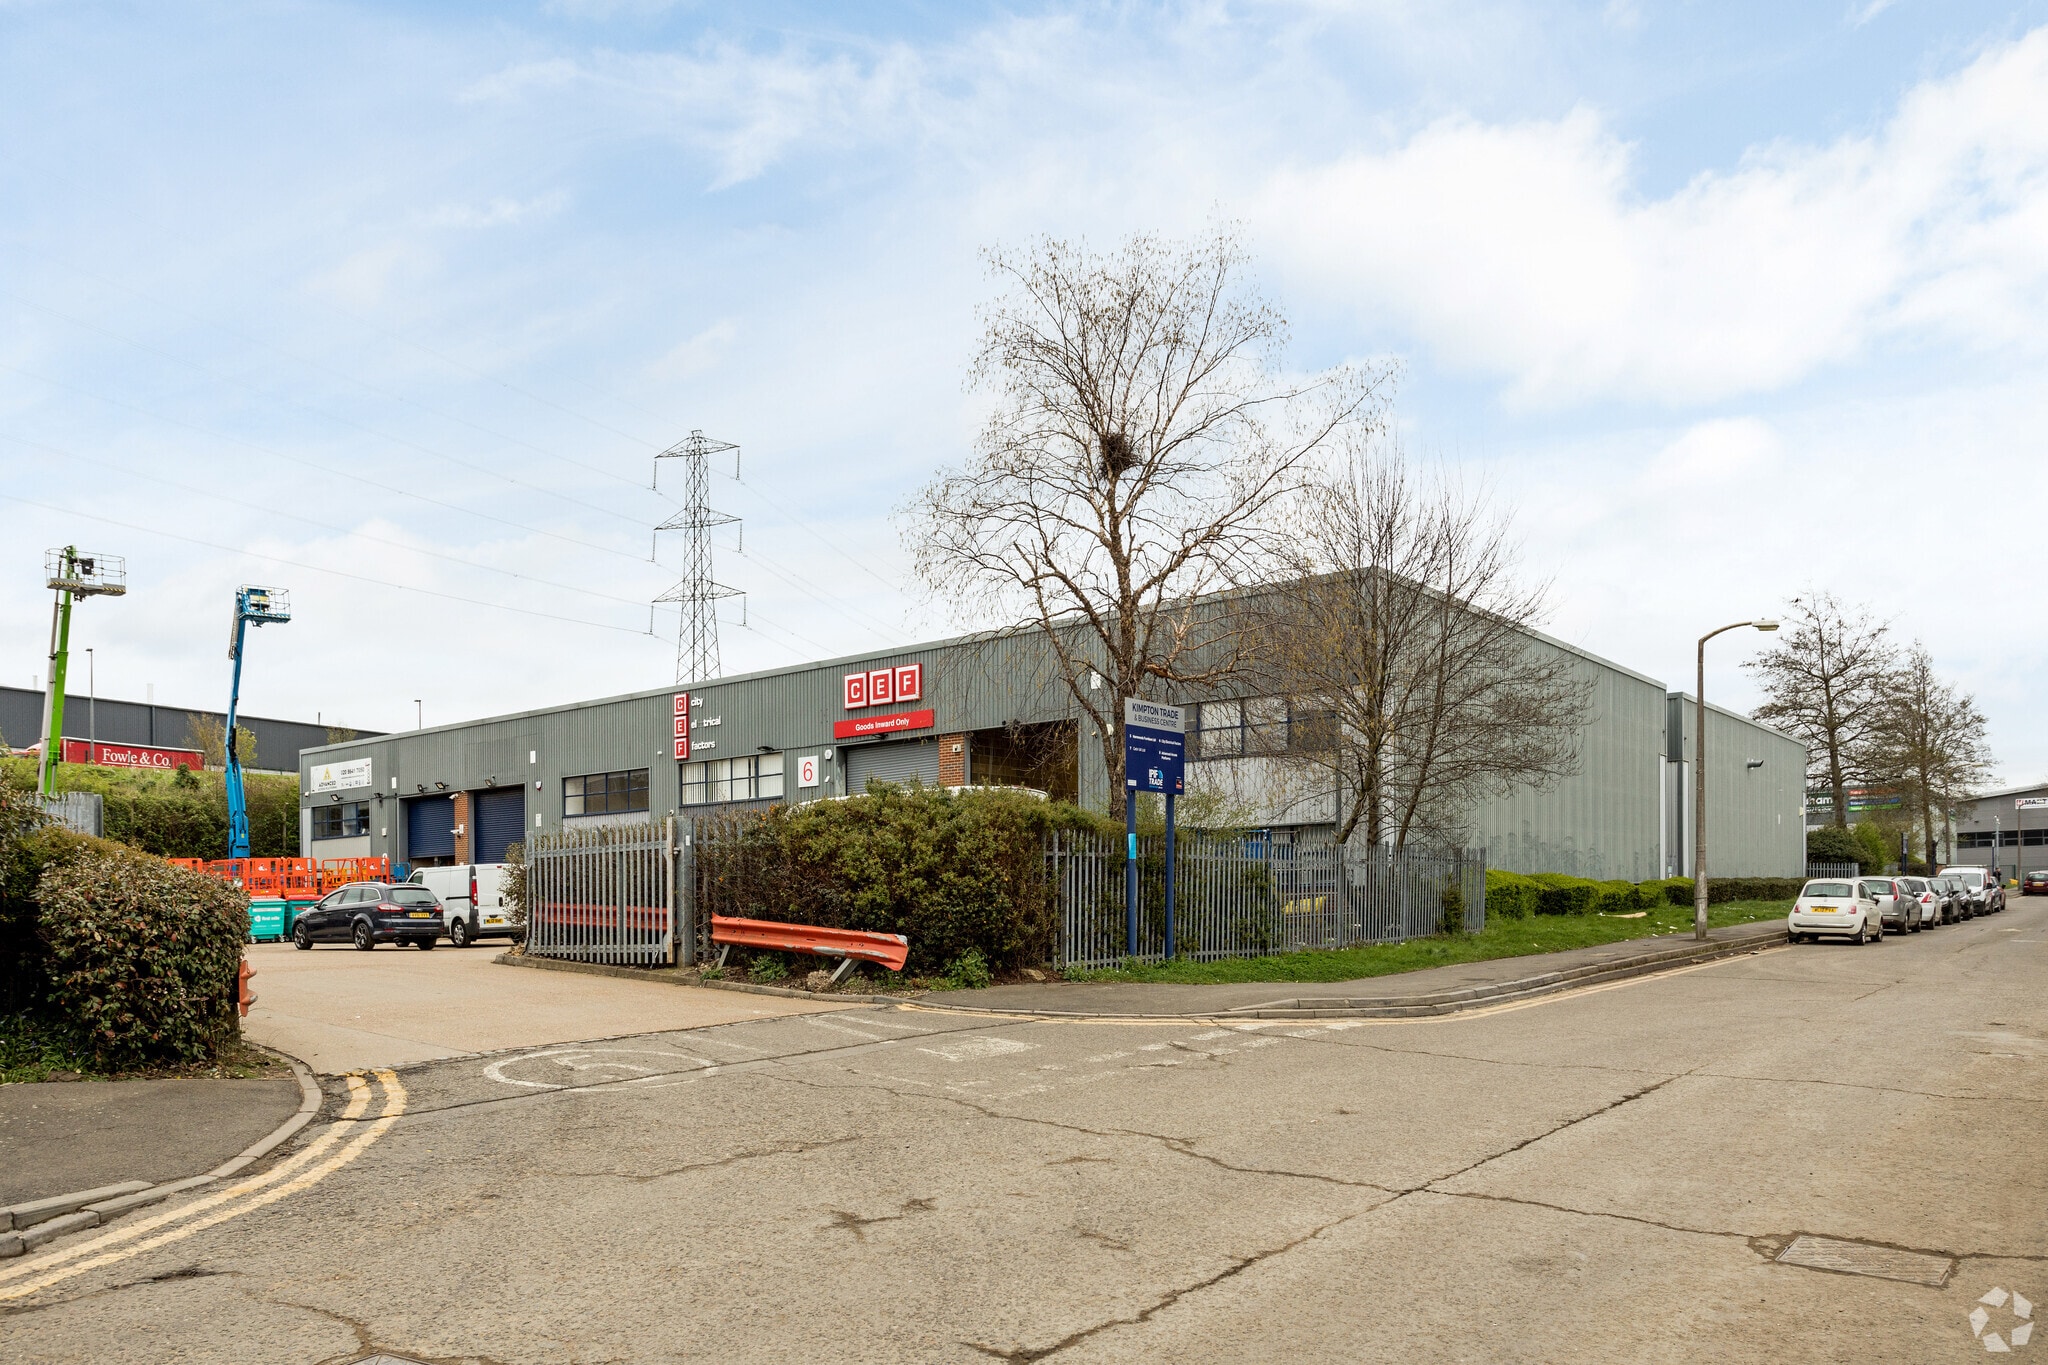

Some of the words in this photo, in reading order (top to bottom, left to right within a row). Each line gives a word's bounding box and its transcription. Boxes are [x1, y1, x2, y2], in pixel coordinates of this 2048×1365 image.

[691, 696, 704, 708] city
[1132, 702, 1159, 716] KIMPTON
[1160, 707, 1179, 720] TRADE
[855, 721, 875, 732] Goods
[875, 718, 895, 730] Inward
[895, 717, 910, 727] Only
[1138, 714, 1160, 725] BUSINESS
[1160, 718, 1177, 728] CENTRE
[691, 740, 716, 751] factors
[102, 747, 138, 764] Fowle
[139, 751, 151, 765] &
[153, 752, 171, 767] Co.
[803, 761, 813, 782] 6
[1148, 777, 1163, 786] TRADE
